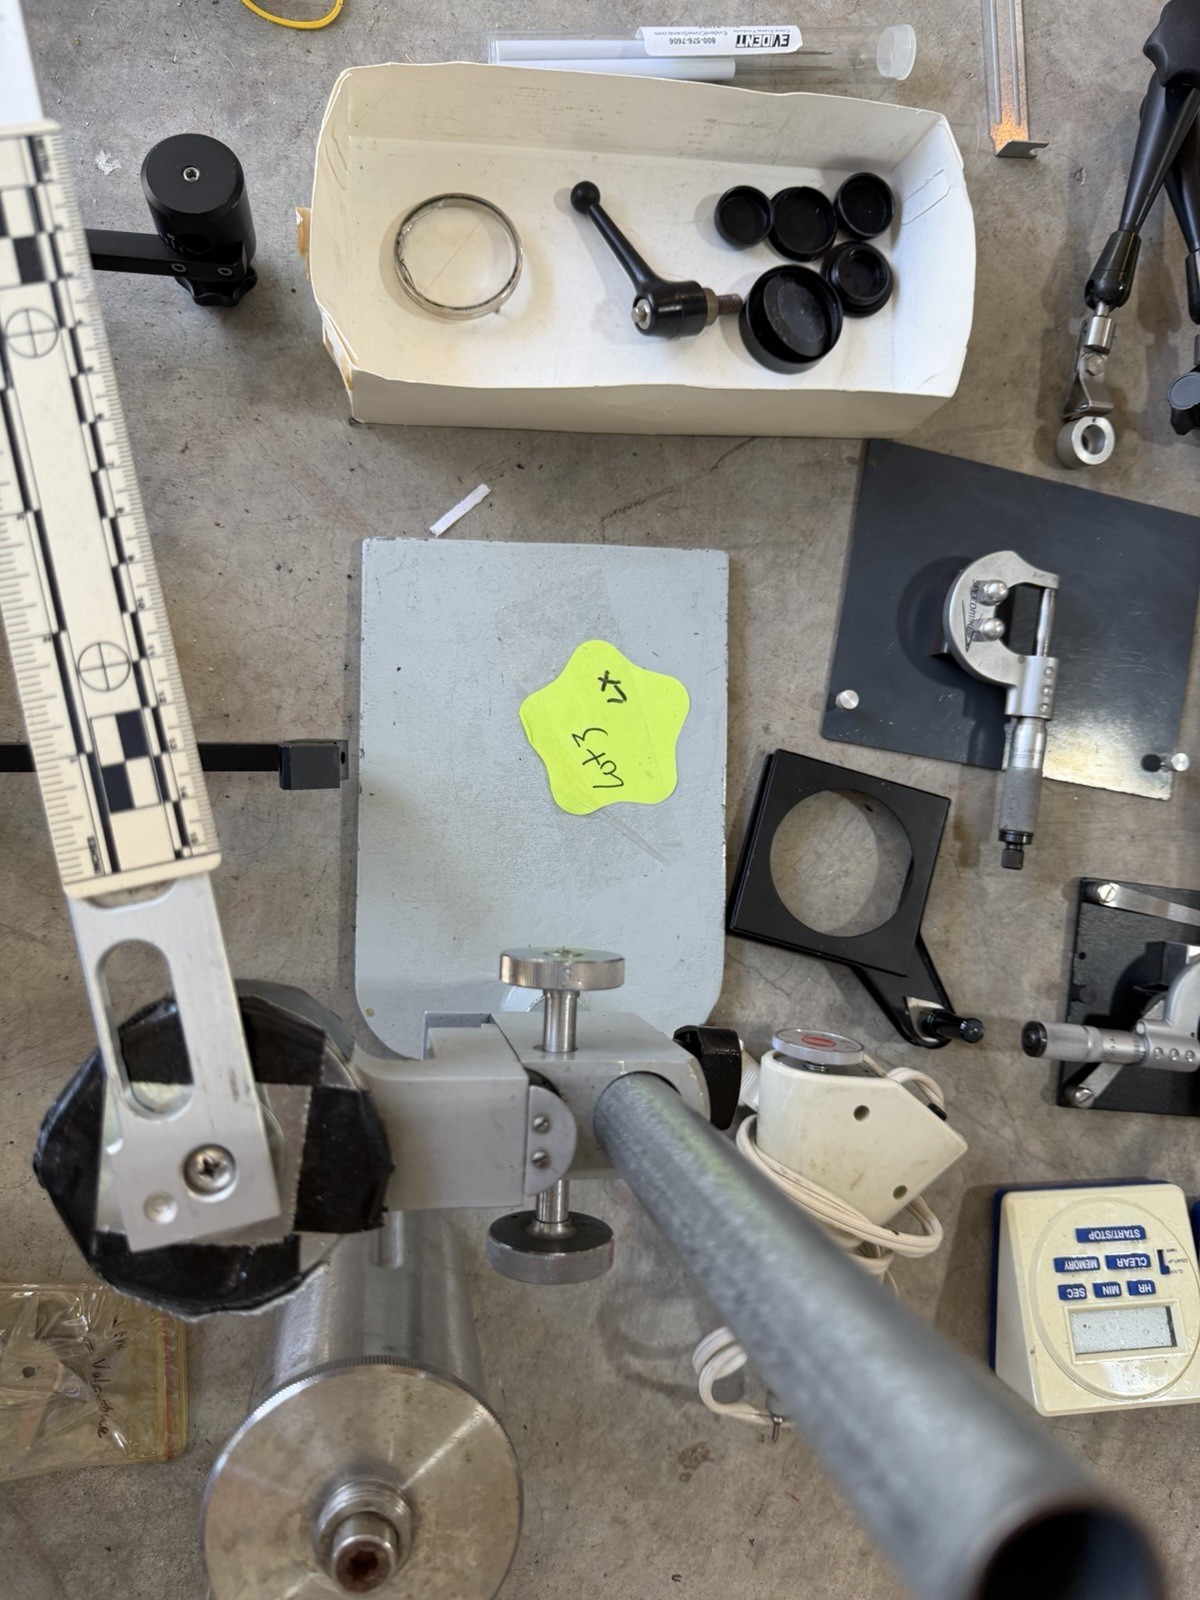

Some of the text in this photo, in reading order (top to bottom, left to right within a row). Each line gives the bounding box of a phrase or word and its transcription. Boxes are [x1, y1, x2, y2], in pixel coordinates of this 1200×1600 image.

[735, 34, 790, 48] EVIDENT
[571, 727, 624, 788] Lot 3
[86, 836, 100, 873] INCHES
[1088, 1228, 1141, 1240] START/STOP
[1064, 1257, 1148, 1270] MEMORY CLEAR
[1066, 1288, 1086, 1298] SEC
[1102, 1284, 1120, 1295] MIN
[1137, 1283, 1152, 1293] HR
